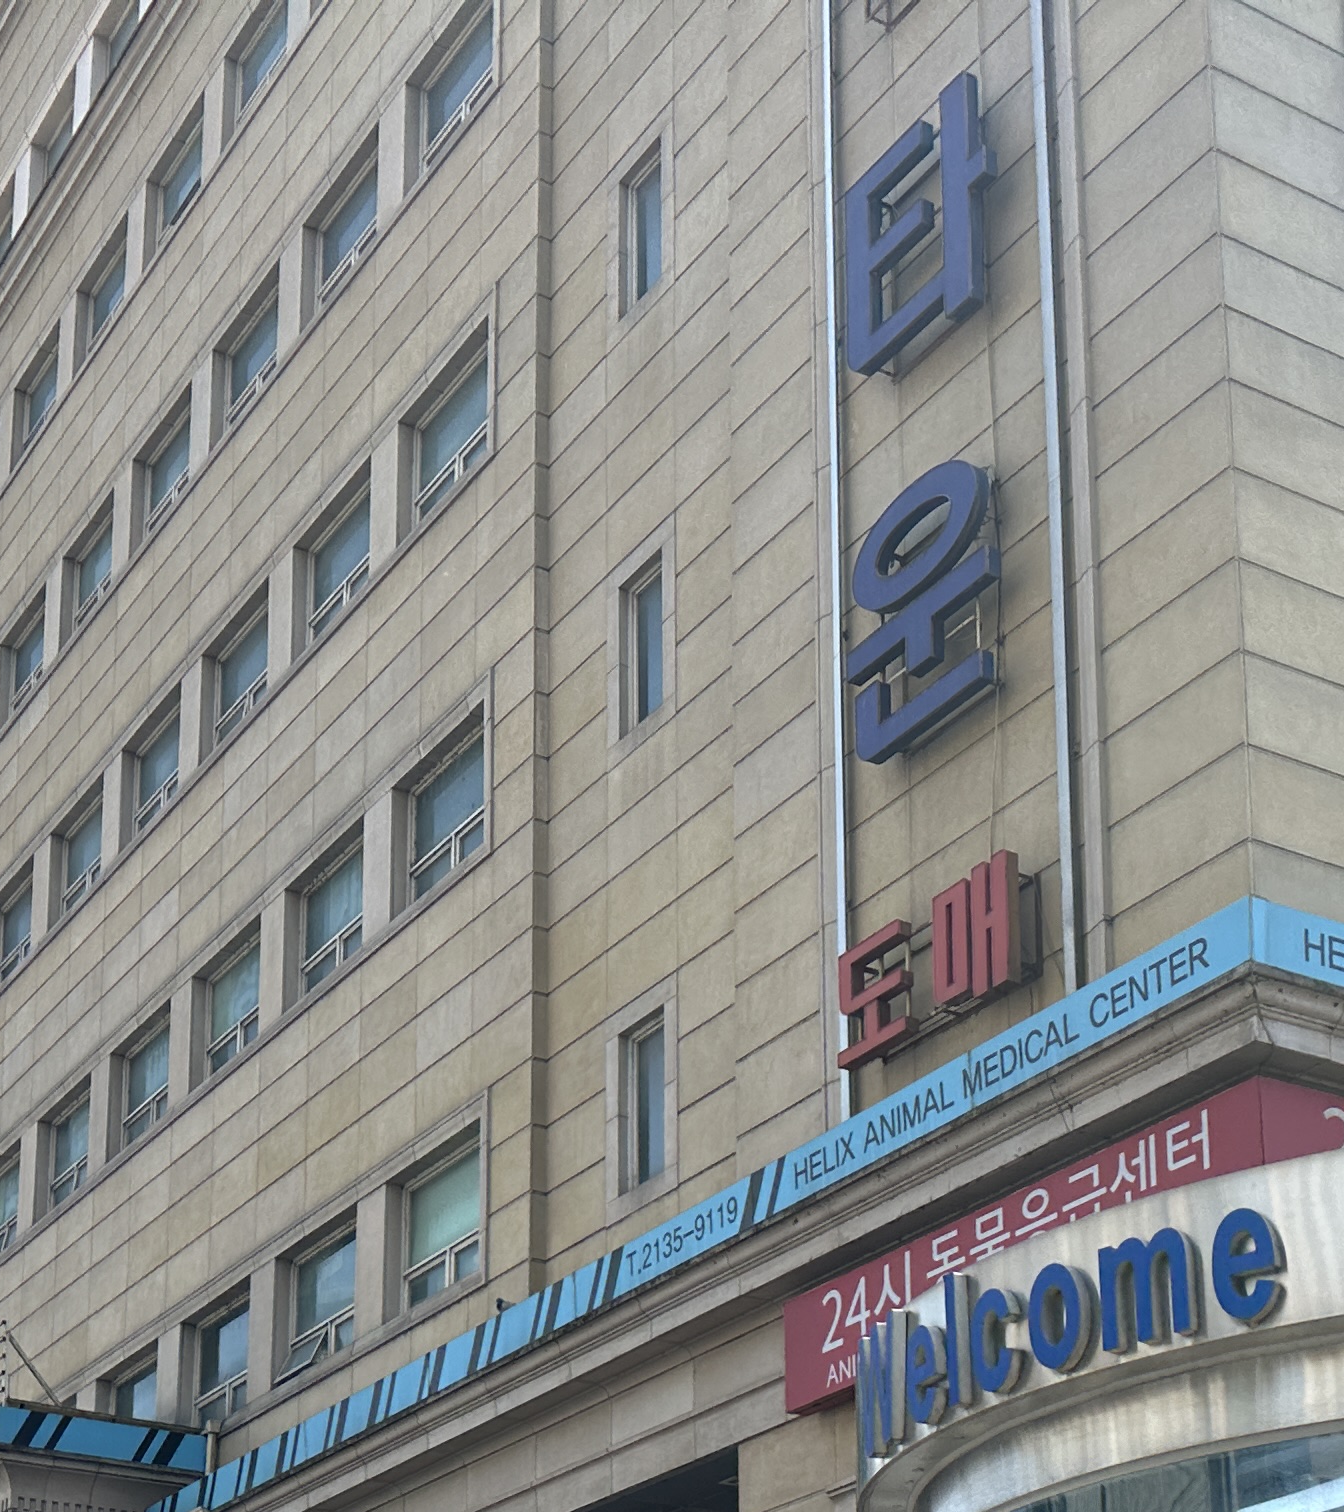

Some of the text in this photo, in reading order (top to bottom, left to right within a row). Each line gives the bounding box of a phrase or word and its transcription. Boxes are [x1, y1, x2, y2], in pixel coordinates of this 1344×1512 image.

[793, 937, 1210, 1191] HELIX ANIMAL MEDICAL CENTER
[838, 850, 1024, 1069] 도매
[625, 1195, 739, 1279] T.2135-9119
[821, 1250, 912, 1354] 24시
[858, 1207, 1287, 1458] Welcome
